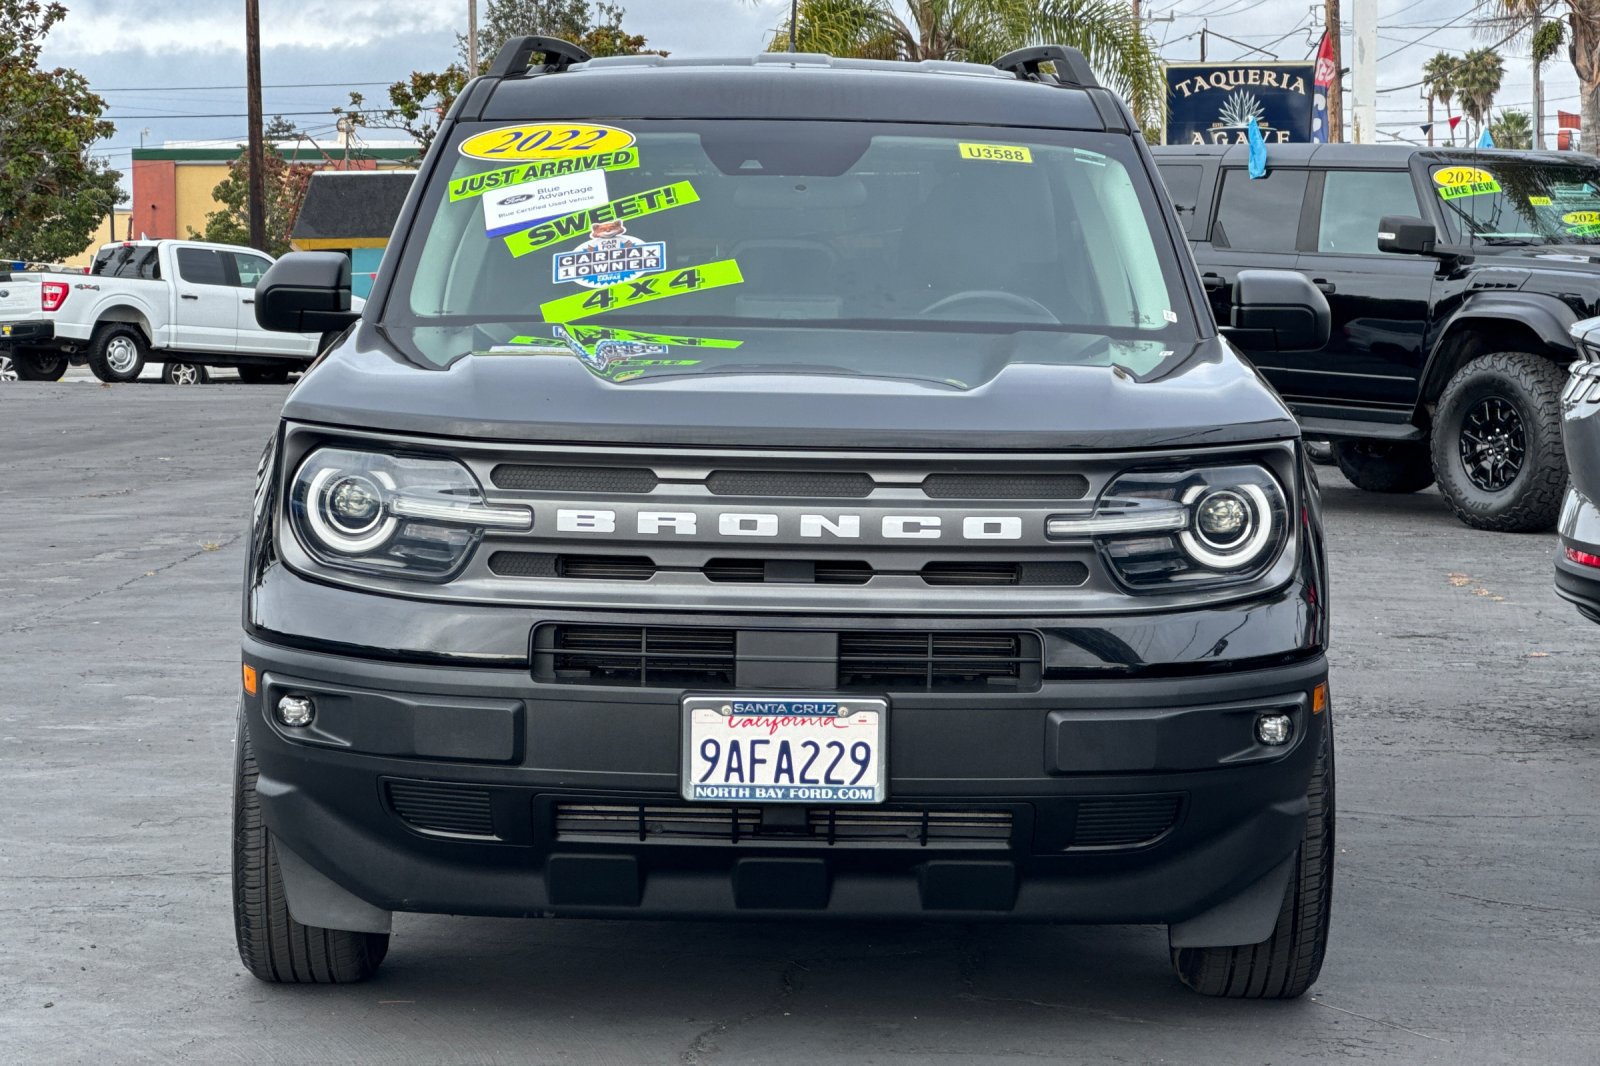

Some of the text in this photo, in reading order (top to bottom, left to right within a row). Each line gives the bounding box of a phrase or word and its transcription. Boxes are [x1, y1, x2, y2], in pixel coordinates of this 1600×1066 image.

[1175, 69, 1306, 97] TAQUERIA
[484, 130, 608, 154] 2022
[968, 147, 1025, 161] U3588
[454, 151, 633, 196] JUST ARRIVED
[1446, 171, 1483, 184] 2023
[537, 185, 560, 195] Blue
[538, 186, 593, 200] Advantage
[1444, 181, 1494, 197] LIKE NEW
[498, 194, 595, 219] Blue Certified Used Vehicle
[527, 187, 678, 247] SWEET!
[562, 248, 657, 266] CARFAX
[556, 508, 1022, 541] BRONCO
[733, 702, 837, 715] SANTA CRUZ
[728, 716, 849, 735] California
[699, 738, 872, 786] 9AFA229
[695, 786, 873, 800] NORTH BAY FORD.COM
